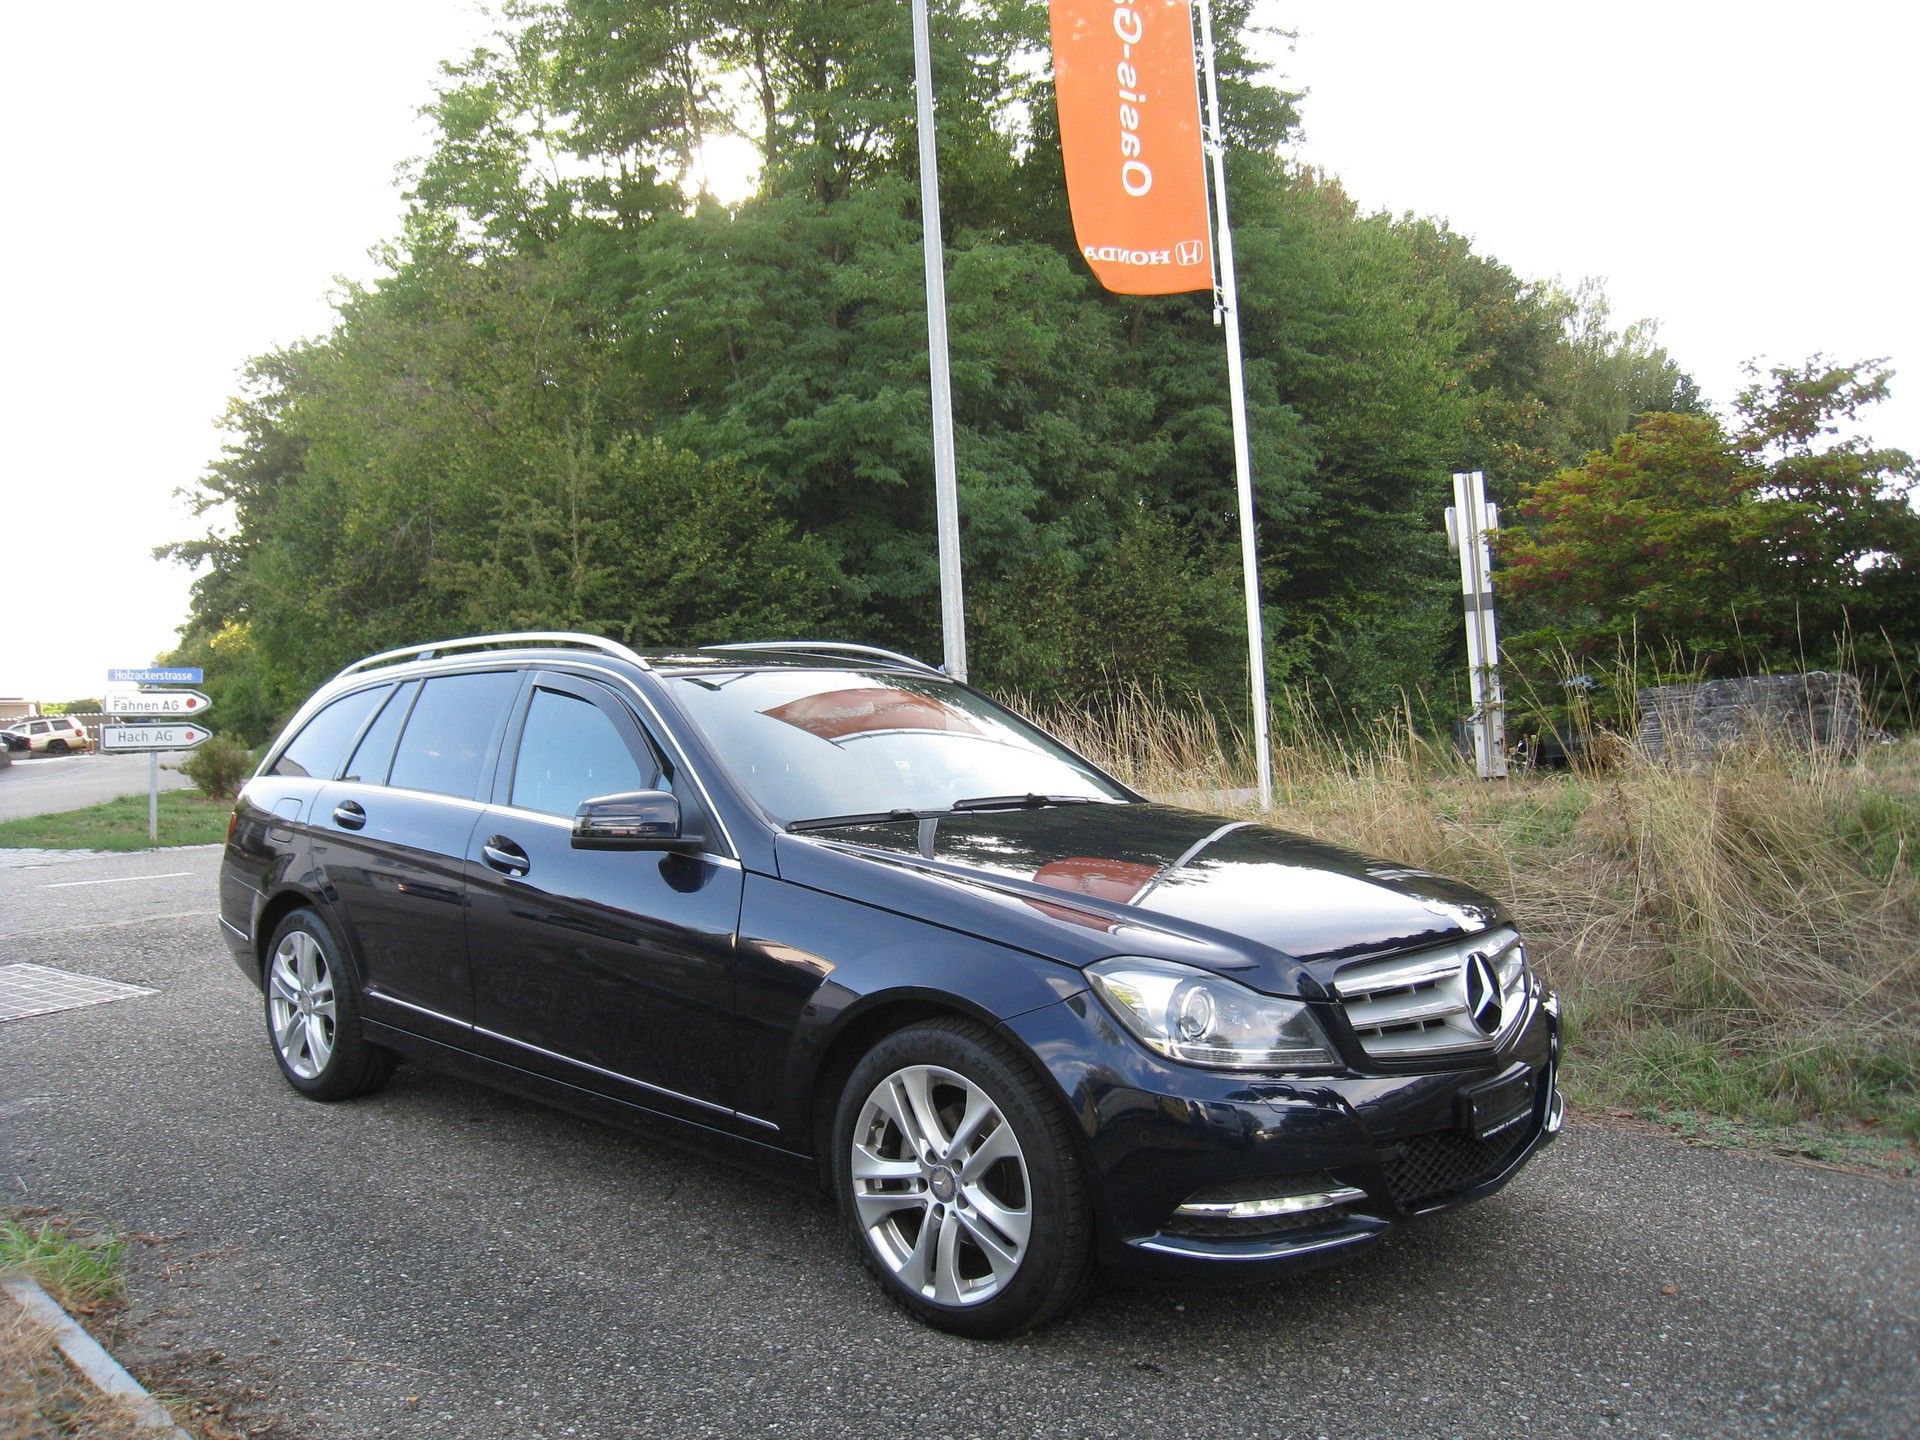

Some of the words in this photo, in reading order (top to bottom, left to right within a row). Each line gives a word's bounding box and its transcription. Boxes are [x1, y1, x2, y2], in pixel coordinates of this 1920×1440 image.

[114, 669, 193, 681] Holzackerstrasse
[113, 700, 159, 711] Fahnen
[162, 700, 179, 711] AG
[118, 731, 149, 743] Hach
[154, 730, 173, 742] AG
